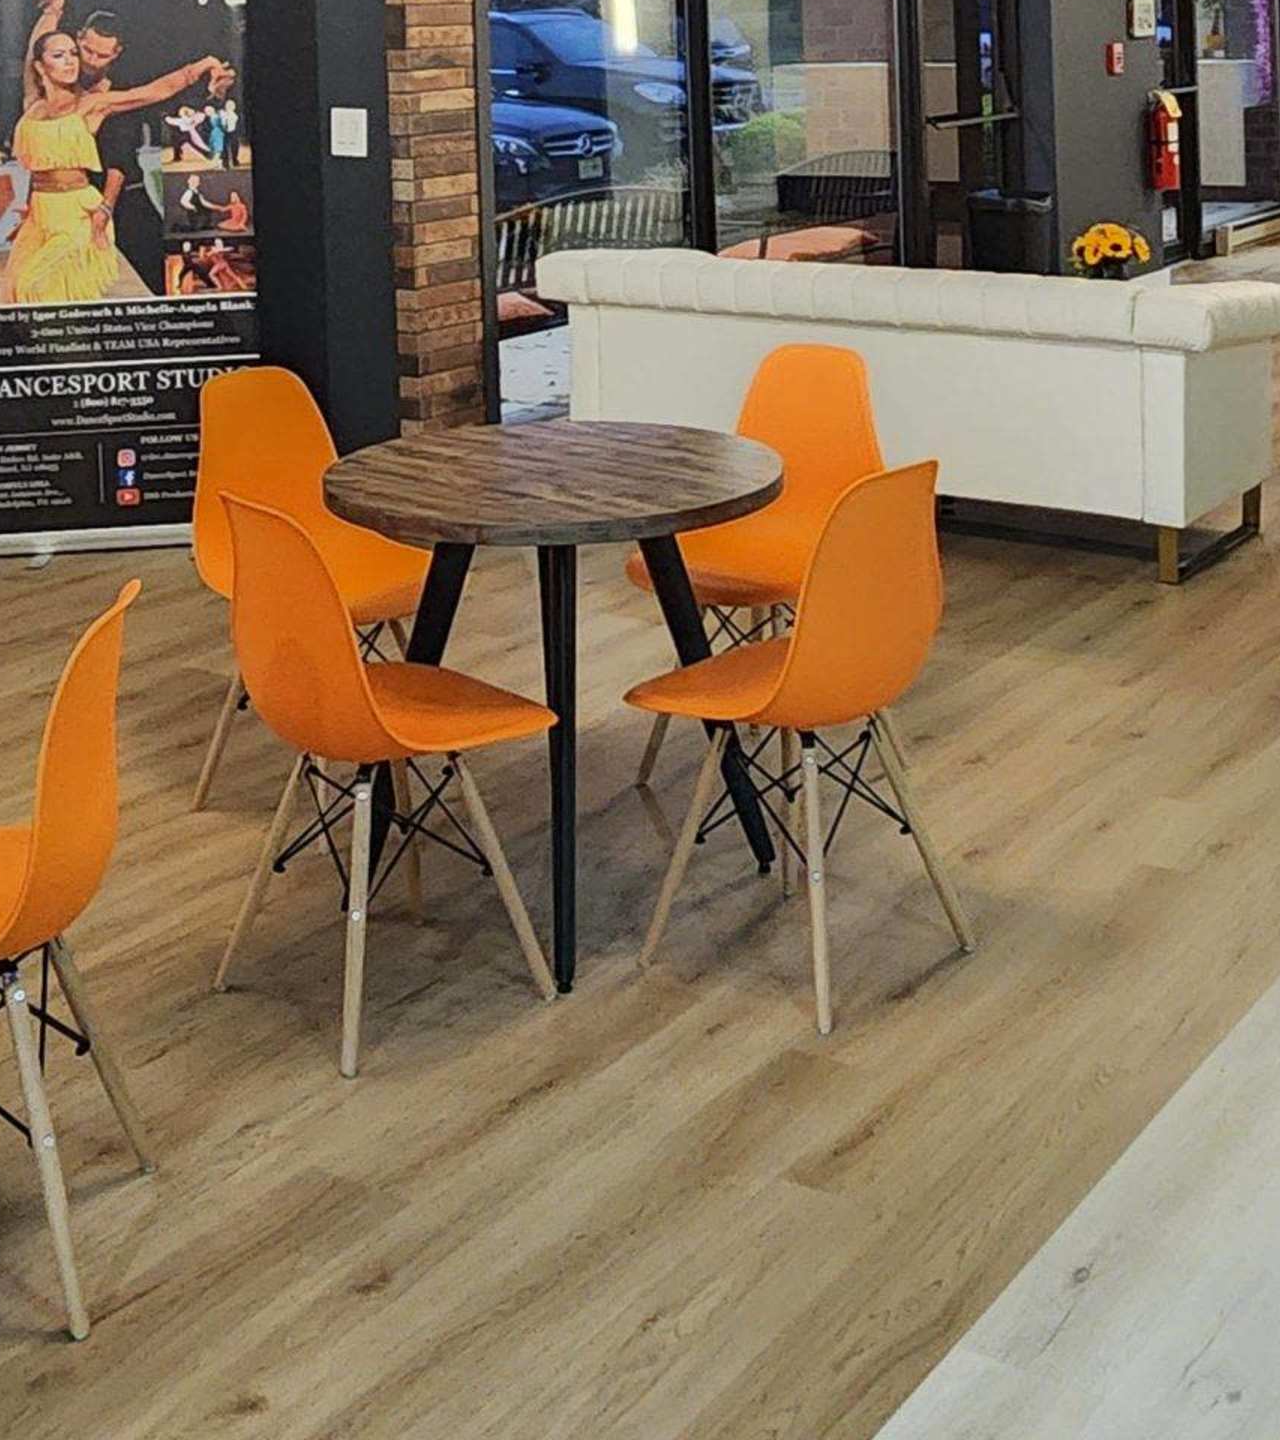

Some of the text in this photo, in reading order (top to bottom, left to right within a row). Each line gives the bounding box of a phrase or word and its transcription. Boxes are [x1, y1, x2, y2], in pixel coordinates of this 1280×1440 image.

[17, 312, 29, 323] by
[33, 311, 56, 322] Igor
[114, 306, 124, 316] &
[66, 324, 100, 335] United
[102, 322, 133, 333] States
[159, 320, 214, 332] Champions
[15, 344, 46, 355] World
[48, 342, 91, 353] Finalists
[104, 339, 136, 350] TEAM
[162, 335, 240, 348] Representatives
[156, 366, 249, 391] STU
